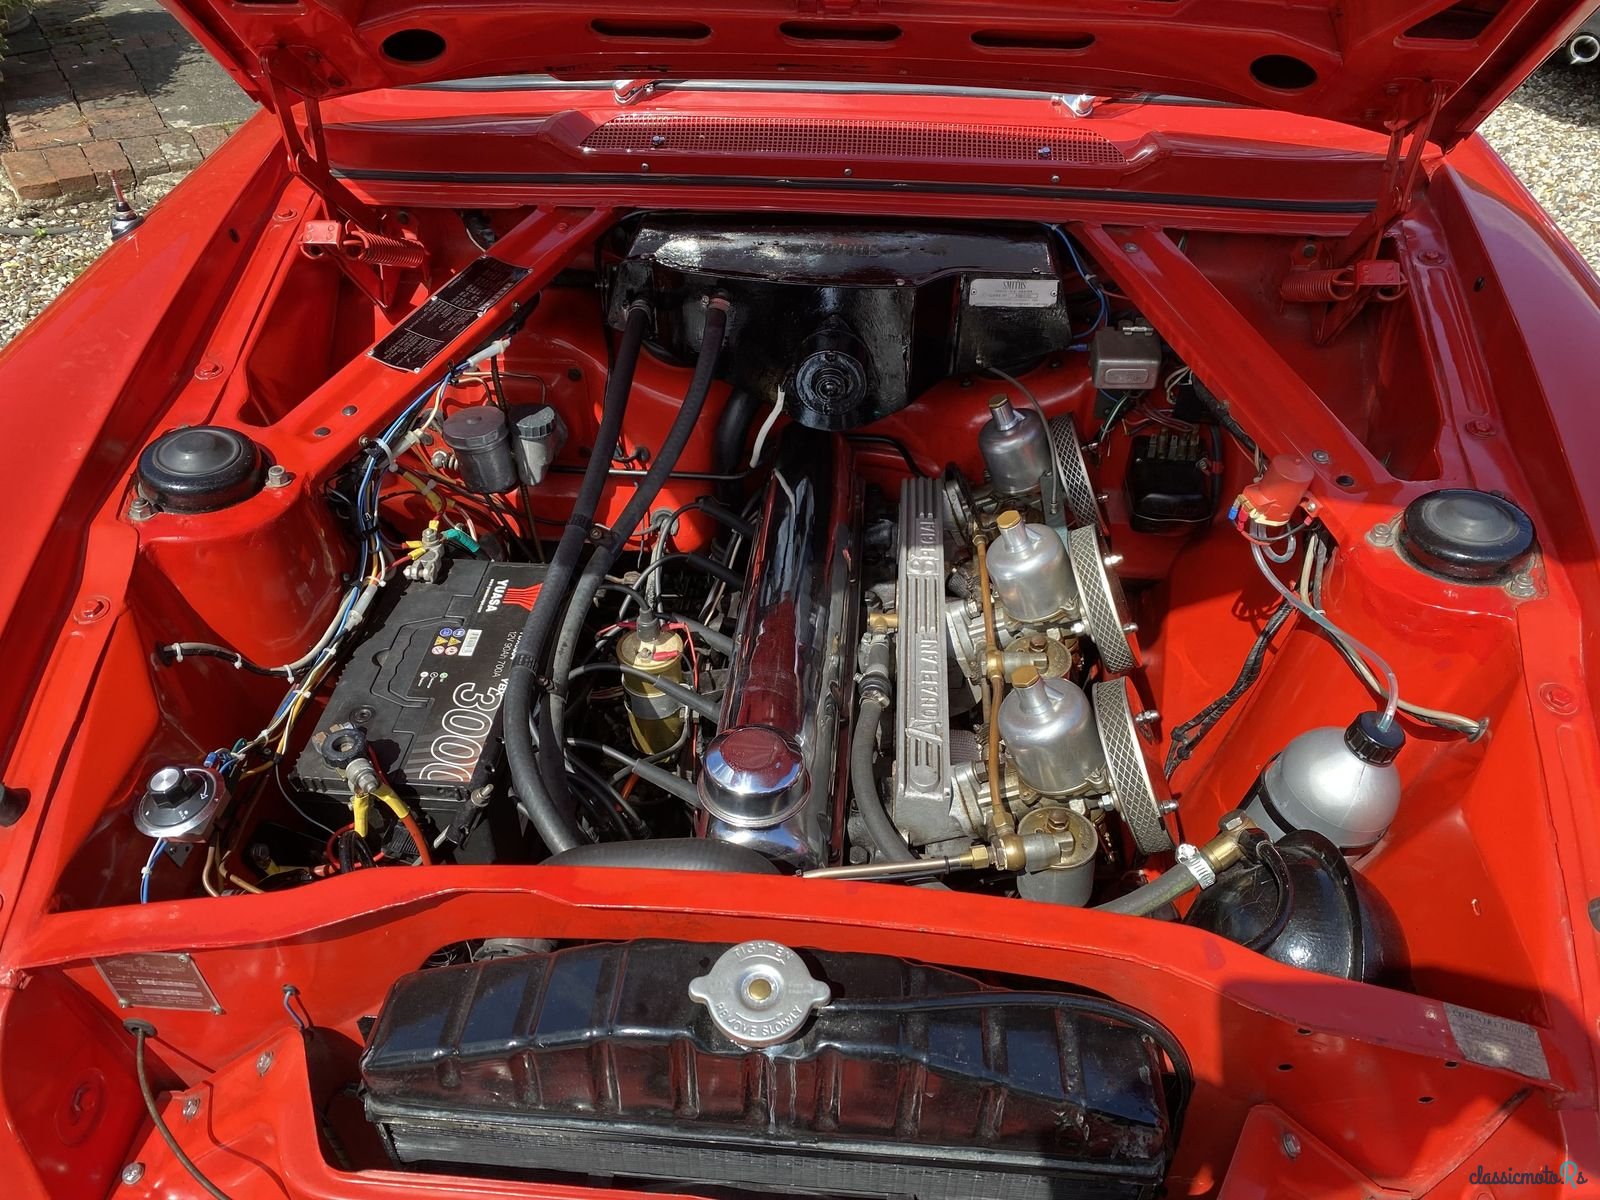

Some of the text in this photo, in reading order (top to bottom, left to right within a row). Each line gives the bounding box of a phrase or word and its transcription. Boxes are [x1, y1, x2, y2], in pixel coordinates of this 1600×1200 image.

[485, 579, 509, 613] YUASA
[507, 631, 517, 642] 12V
[501, 642, 512, 659] 90Ah
[492, 660, 506, 678] 700A
[762, 1004, 803, 1037] SLOWLY
